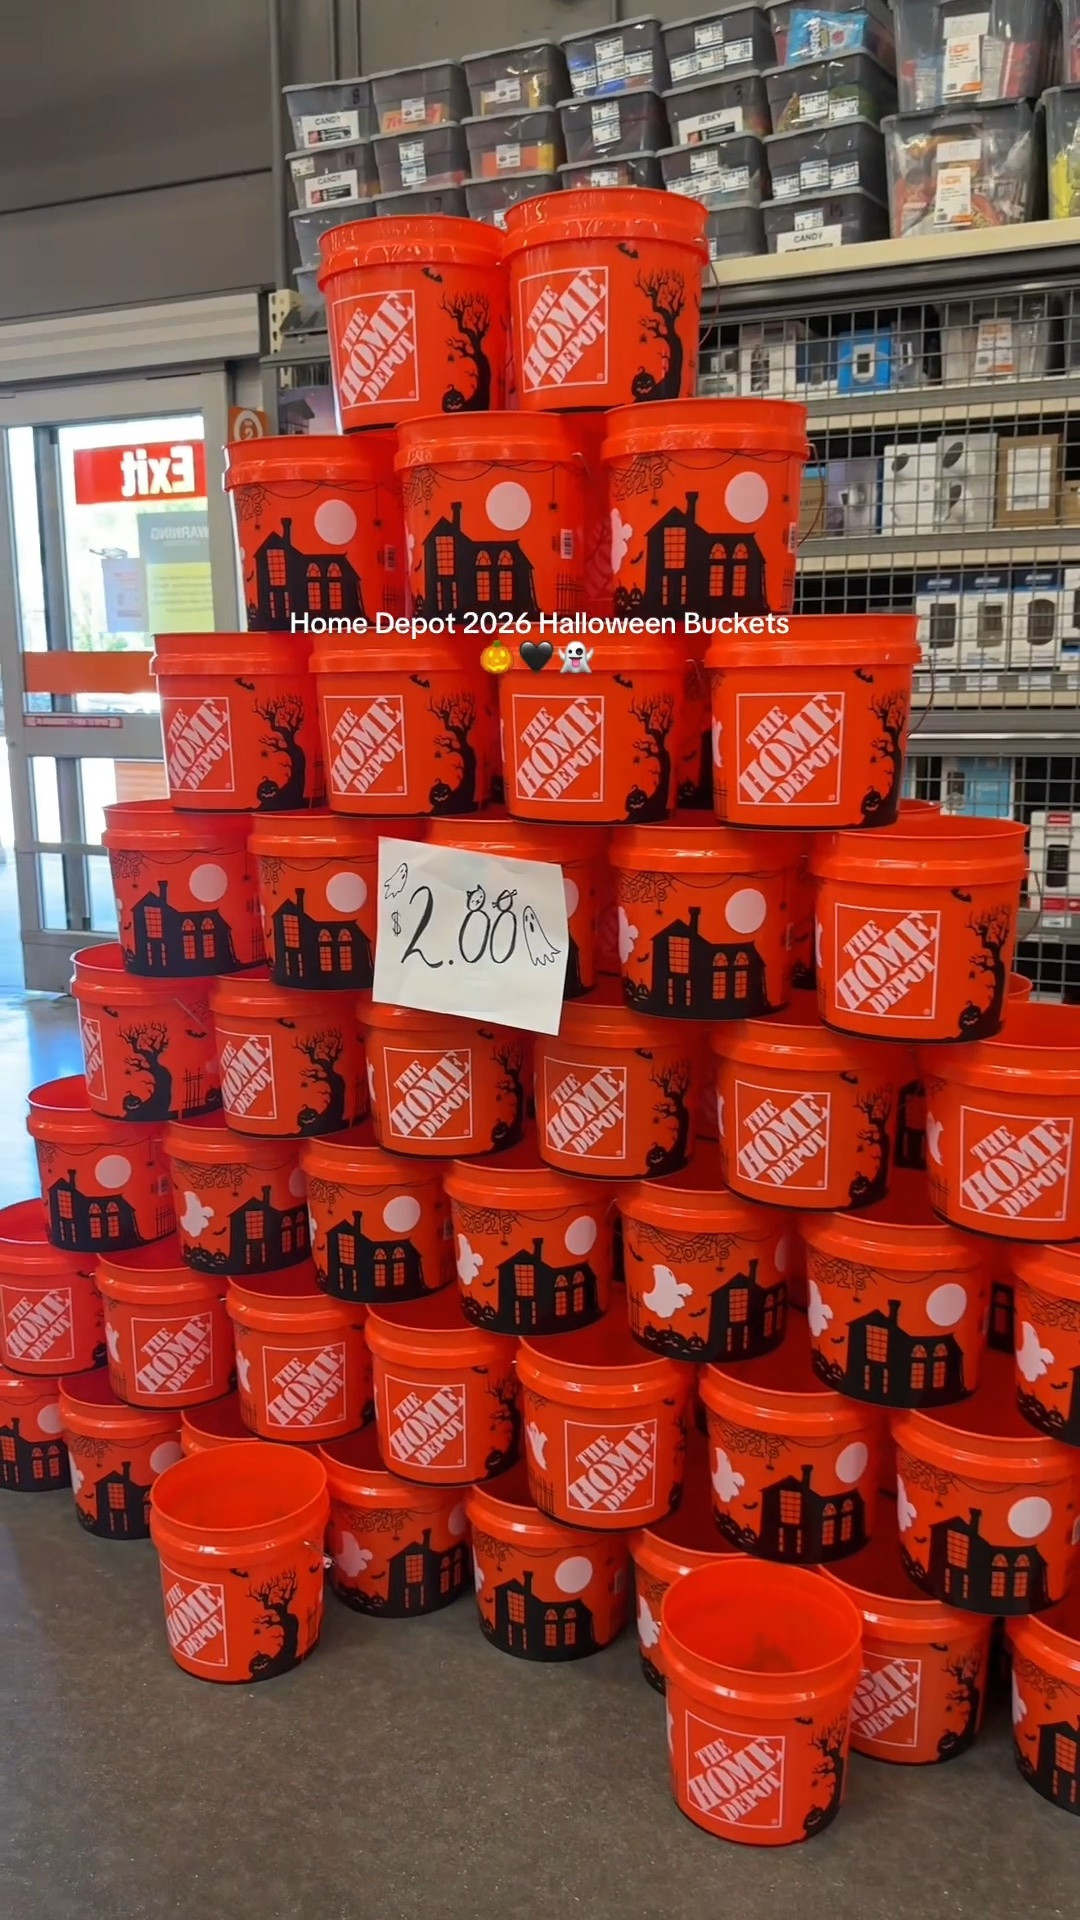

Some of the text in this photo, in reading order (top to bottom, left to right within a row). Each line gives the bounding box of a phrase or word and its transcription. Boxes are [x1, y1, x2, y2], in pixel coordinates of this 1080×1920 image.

[314, 115, 341, 126] CANDY
[698, 113, 722, 126] JERKY
[318, 174, 342, 185] CANDY
[794, 232, 823, 243] CANDY
[340, 306, 370, 355] THE
[524, 268, 606, 389] HOME
[527, 285, 557, 332] THE
[340, 292, 415, 406] HOME
[362, 331, 416, 402] DEPOT
[548, 310, 606, 385] DEPOT
[168, 708, 188, 742] THE
[169, 698, 230, 788] HOME
[330, 697, 402, 793] HOME
[331, 708, 358, 745] THE
[516, 697, 604, 798] HOME
[520, 706, 552, 747] THE
[738, 694, 843, 802] HOME
[746, 706, 789, 750] THE
[186, 732, 230, 790] DEPOT
[352, 732, 404, 794] DEPOT
[542, 735, 602, 800] DEPOT
[772, 736, 841, 803] DEPOT
[390, 884, 518, 968] $2.88
[843, 920, 884, 960] THE
[836, 912, 938, 1010] HOME
[868, 952, 936, 1015] DEPOT
[220, 1041, 237, 1071] THE
[221, 1036, 271, 1117] HOME
[393, 1060, 426, 1094] THE
[235, 1067, 274, 1116] DEPOT
[390, 1051, 471, 1136] HOME
[418, 1084, 472, 1138] DEPOT
[546, 1068, 626, 1151] HOME
[550, 1073, 580, 1106] THE
[743, 1099, 780, 1134] THE
[570, 1100, 624, 1155] DEPOT
[738, 1094, 829, 1180] HOME
[970, 1126, 1017, 1164] THE
[766, 1128, 827, 1186] DEPOT
[960, 1118, 1073, 1212] HOME
[999, 1156, 1068, 1218] DEPOT
[464, 1214, 515, 1234] 2026
[667, 1240, 732, 1264] 2026
[6, 1290, 70, 1358] HOME
[8, 1296, 34, 1323] THE
[28, 1315, 72, 1360] DEPOT
[136, 1316, 211, 1392] HOME
[142, 1327, 174, 1356] THE
[164, 1340, 211, 1392] DEPOT
[267, 1346, 344, 1426] HOME
[273, 1357, 306, 1388] THE
[296, 1372, 344, 1426] DEPOT
[390, 1386, 465, 1460] HOME
[392, 1392, 422, 1422] THE
[414, 1416, 466, 1466] DEPOT
[568, 1425, 655, 1510] HOME
[576, 1435, 615, 1467] THE
[601, 1454, 654, 1512] DEPOT
[166, 1582, 186, 1608] THE
[166, 1584, 222, 1648] HOME
[182, 1614, 224, 1657] DEPOT
[858, 1692, 917, 1737] DEPOT
[688, 1737, 782, 1812] HOME
[694, 1738, 732, 1768] THE
[720, 1771, 782, 1822] DEPOT
